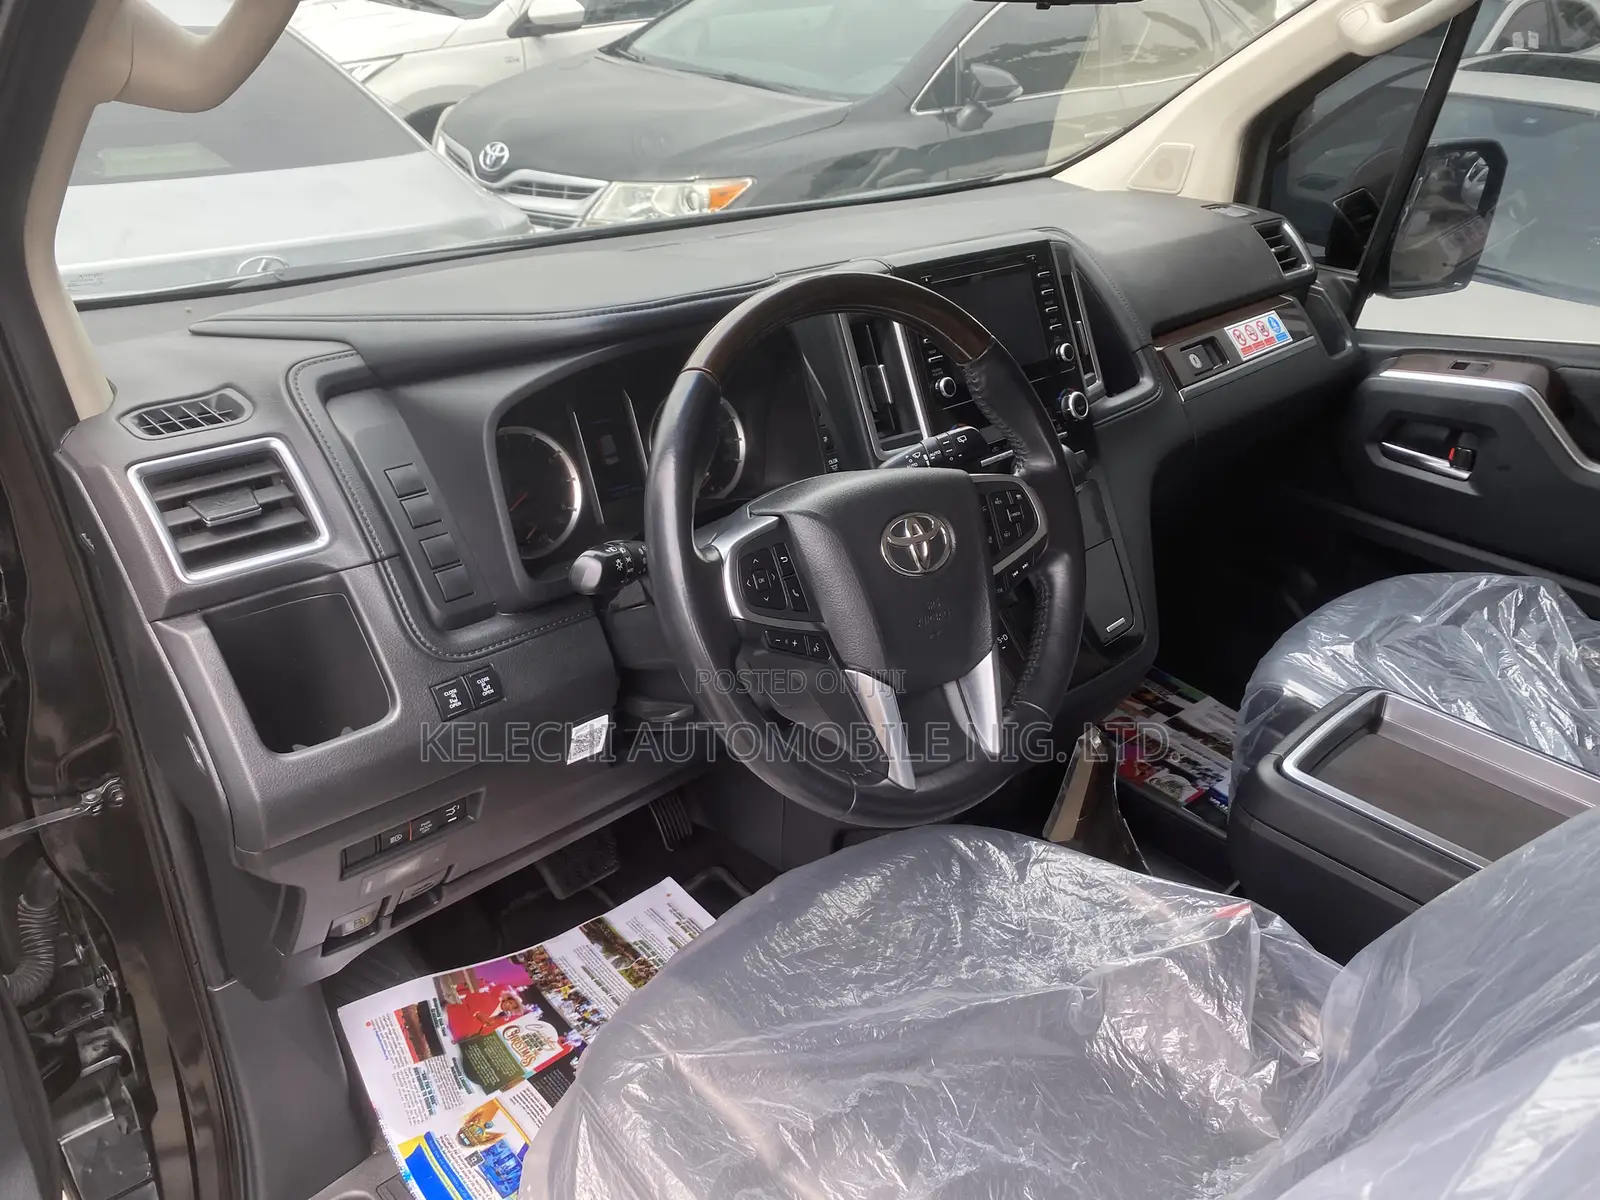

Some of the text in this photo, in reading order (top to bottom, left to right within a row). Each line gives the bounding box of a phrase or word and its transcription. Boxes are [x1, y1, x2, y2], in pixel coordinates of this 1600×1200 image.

[476, 676, 490, 685] CLOSE
[443, 688, 458, 697] CLOSE
[481, 688, 495, 697] OPEN
[449, 701, 462, 709] OPEN
[502, 1025, 537, 1067] CHRISTMAS
